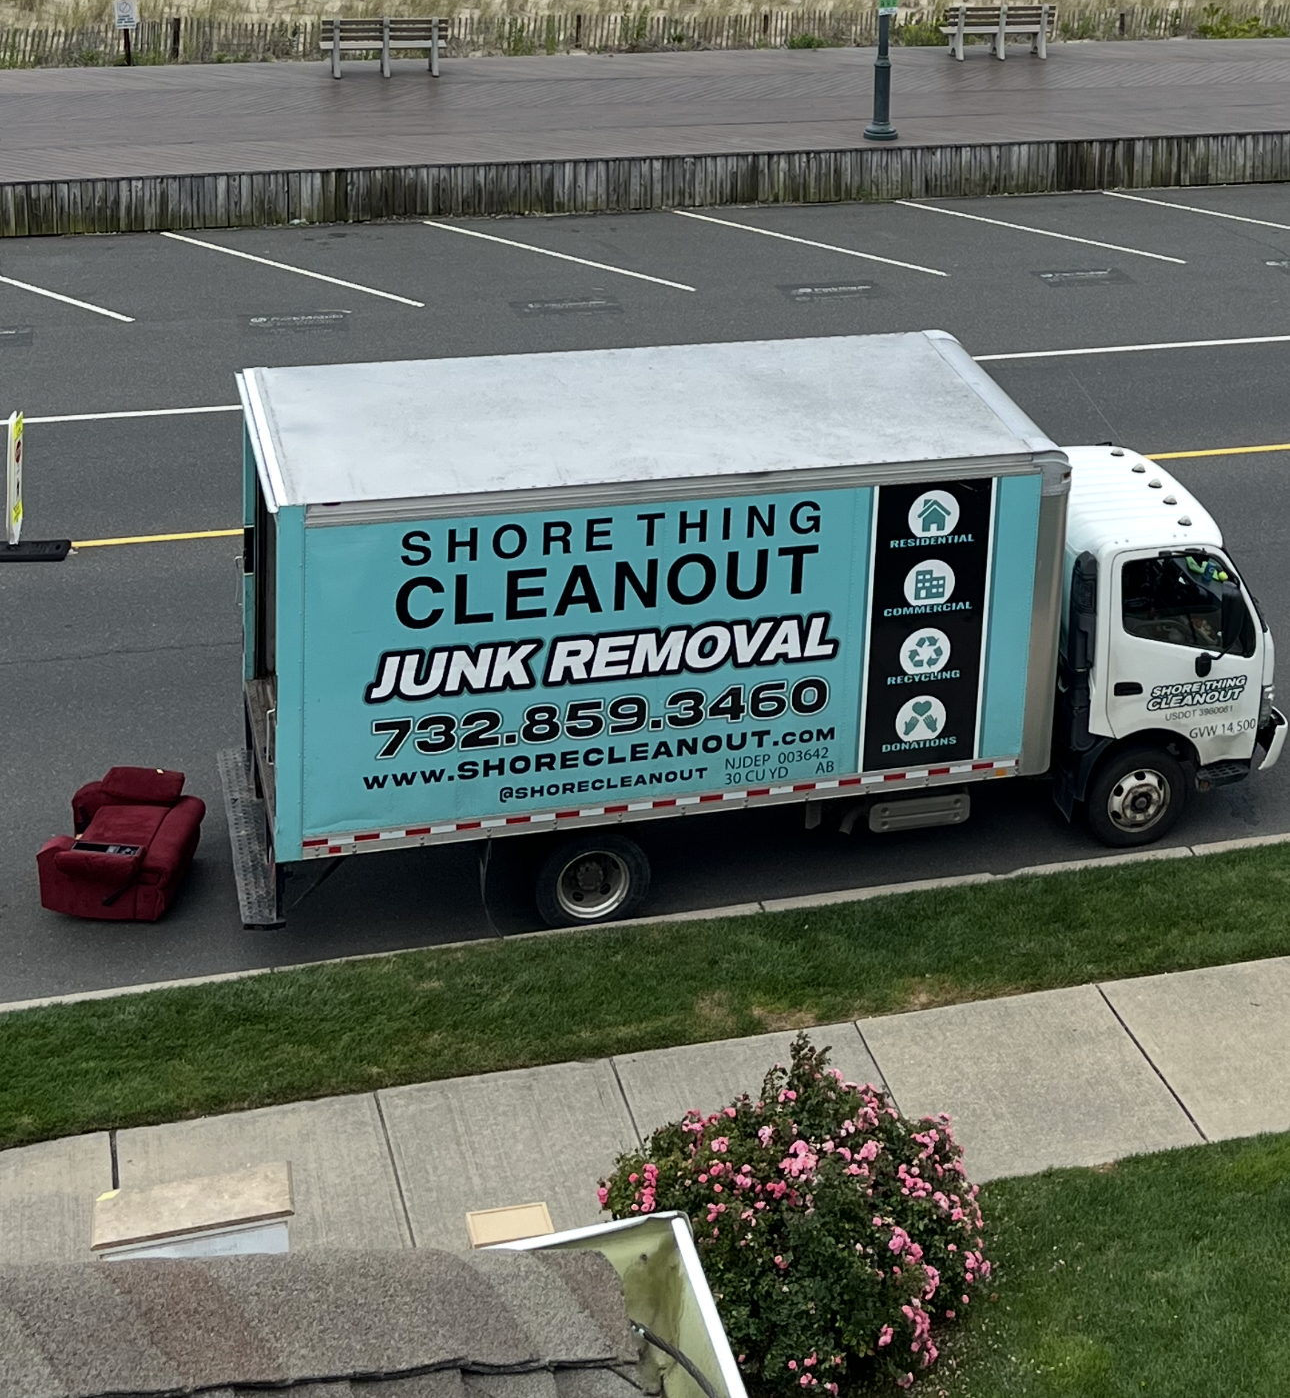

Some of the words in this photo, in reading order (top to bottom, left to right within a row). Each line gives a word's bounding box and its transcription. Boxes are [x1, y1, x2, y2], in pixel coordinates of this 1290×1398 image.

[401, 517, 613, 567] SHORE
[637, 501, 821, 546] THING
[890, 533, 974, 548] RESIDENTIAL
[396, 544, 819, 629] CLEANOUT
[883, 601, 972, 617] COMMERCIAL
[366, 638, 543, 702] JUNK
[543, 612, 838, 686] REMOVAL
[887, 669, 960, 685] RECYCLING
[1151, 681, 1202, 698] SHORE
[1203, 675, 1247, 691] THING
[1147, 687, 1244, 711] CLEANOUT
[372, 677, 829, 759] 732.859.3460
[1165, 709, 1197, 721] USDOT
[1189, 724, 1217, 739] GVW
[1221, 718, 1256, 735] 14,500
[882, 736, 957, 753] DONATIONS
[725, 754, 771, 771] NJDEP
[778, 746, 829, 765] 003642
[725, 772, 742, 785] 30
[745, 769, 766, 782] CU
[769, 766, 789, 780] YD
[815, 760, 835, 775] AB
[500, 767, 708, 803] @SHORECLEANOUT
